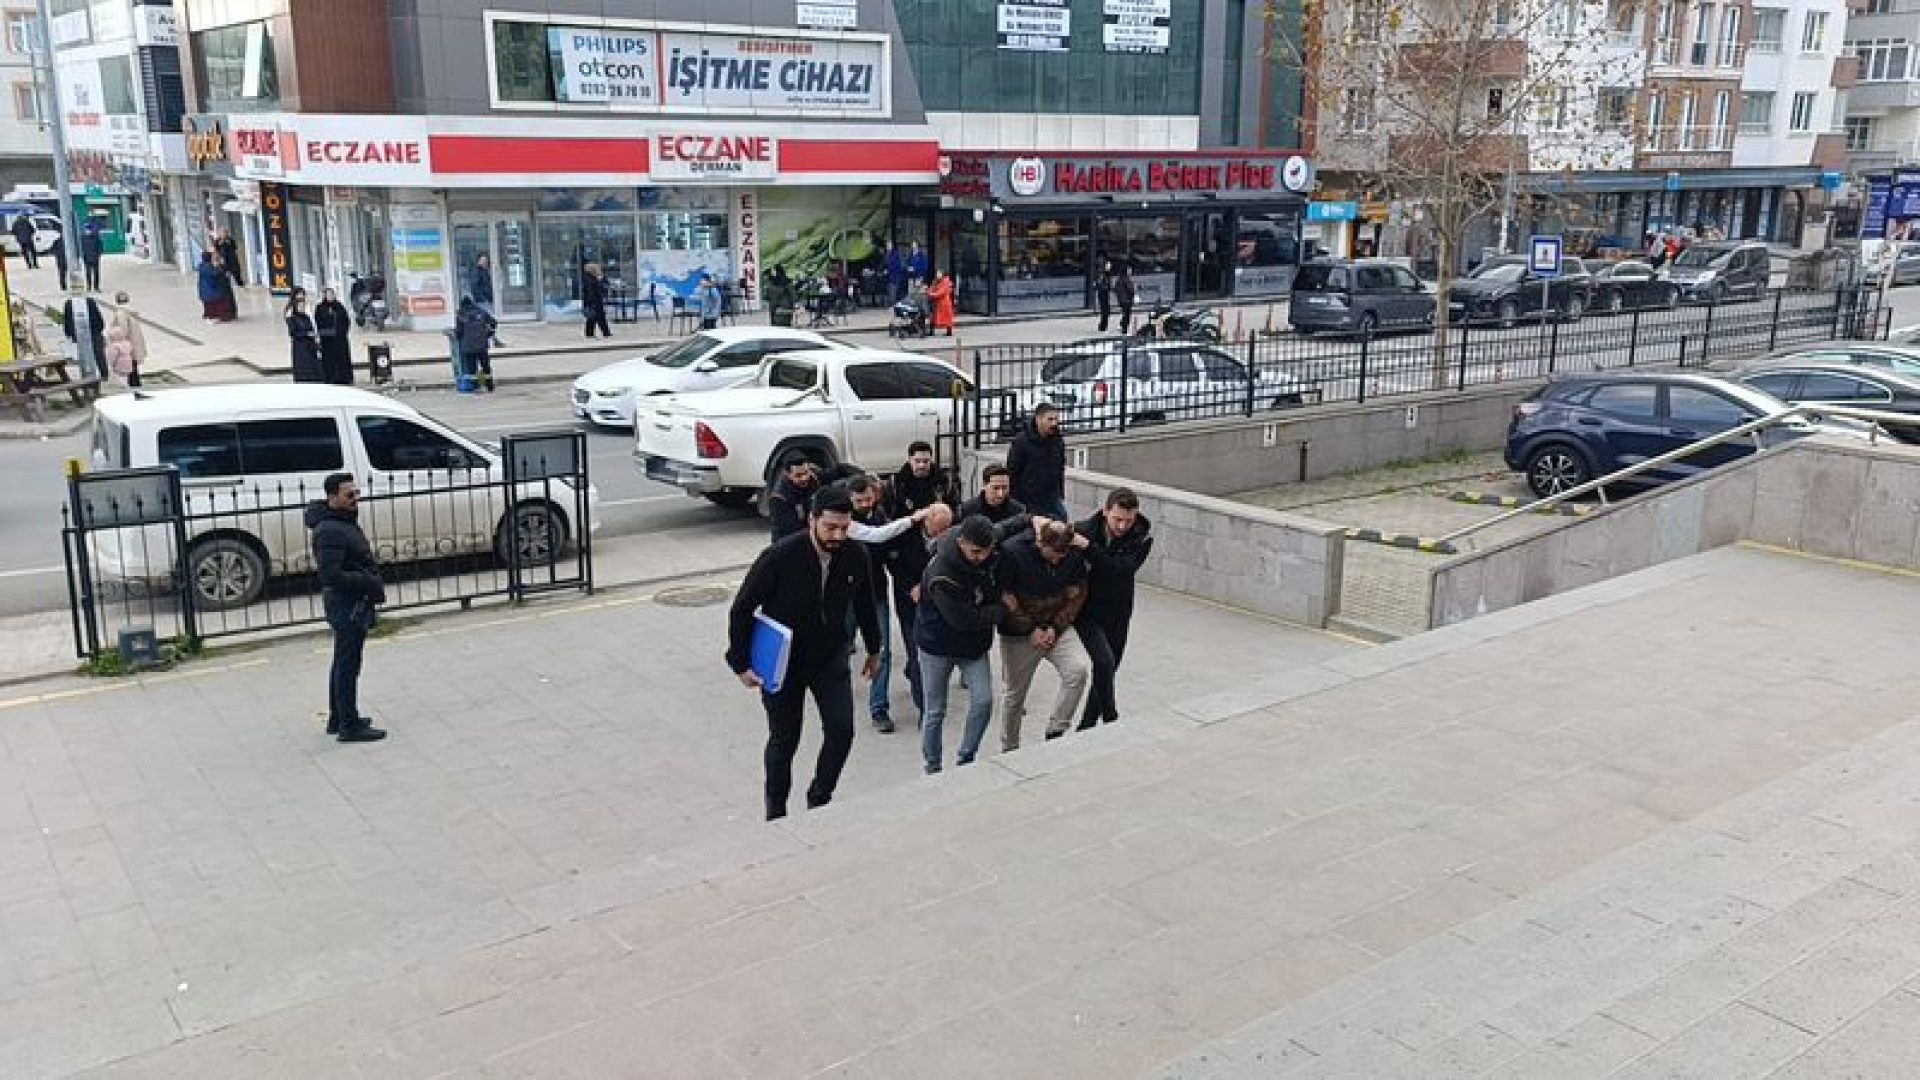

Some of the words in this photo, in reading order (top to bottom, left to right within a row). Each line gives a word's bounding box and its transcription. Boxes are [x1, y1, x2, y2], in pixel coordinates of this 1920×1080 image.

[573, 35, 647, 55] PHILIPS
[579, 57, 645, 79] otcon
[669, 47, 771, 96] İŞİTME
[778, 59, 873, 94] CİHAZI
[307, 141, 420, 164] ECZANE
[658, 135, 771, 162] ECZANE
[741, 194, 756, 301] ECZANE
